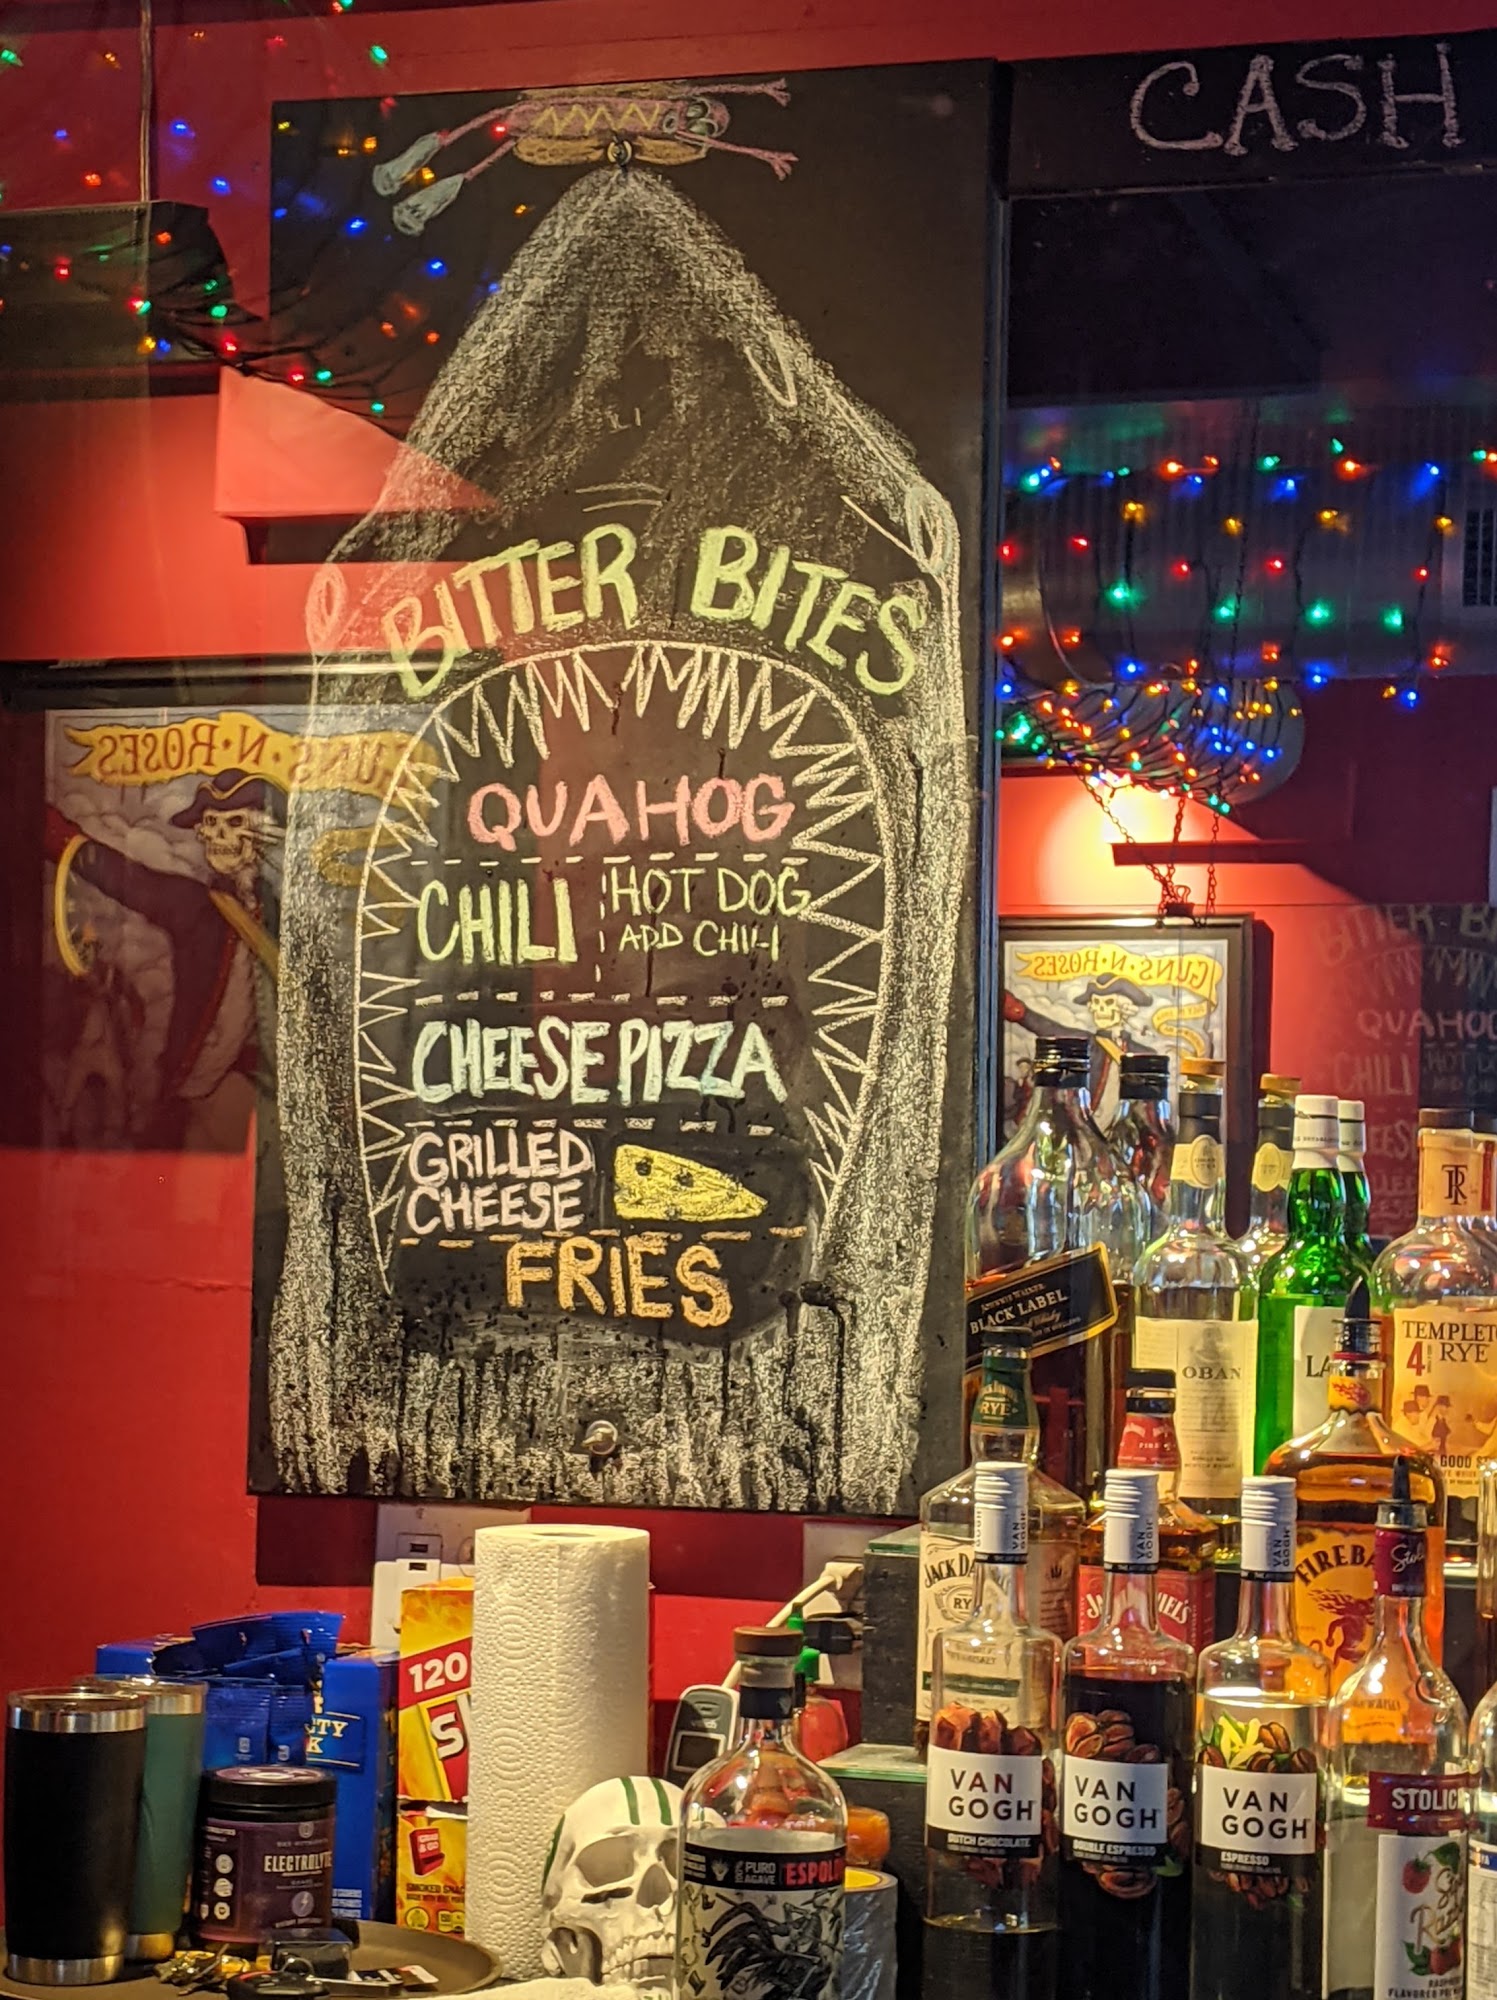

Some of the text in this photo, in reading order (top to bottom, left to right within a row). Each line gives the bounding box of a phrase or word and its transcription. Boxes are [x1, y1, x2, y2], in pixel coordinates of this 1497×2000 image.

[1130, 43, 1465, 156] CASH
[382, 523, 929, 698] BITTER BITES
[466, 774, 795, 852] QUAHOG
[610, 867, 811, 918] HOT DOG
[416, 878, 578, 965] CHILI
[619, 921, 780, 962] ADD CHILI
[411, 1015, 788, 1107] CHEESE PIZZA
[408, 1129, 594, 1187] GRILLED
[406, 1179, 585, 1235] CHEESE
[507, 1235, 733, 1327] FRIES
[970, 1306, 1016, 1334] BLACK
[1018, 1289, 1069, 1316] LABEL
[1406, 1341, 1426, 1376] 4
[1440, 1342, 1490, 1363] RYE
[1182, 1366, 1242, 1380] OBAN
[979, 1401, 1012, 1416] RYE
[1440, 1455, 1472, 1469] GOOD
[1136, 1531, 1145, 1559] VAN
[1273, 1539, 1282, 1567] VAN
[1283, 1529, 1291, 1567] GOGH
[925, 1557, 959, 1588] JACK
[1296, 1544, 1375, 1587] FIREBA
[953, 1597, 973, 1610] RY
[409, 1651, 468, 1694] 120
[950, 1768, 1013, 1794] VAN
[1075, 1775, 1136, 1802] VAN
[948, 1796, 1033, 1821] GOGH
[1222, 1787, 1288, 1813] VAN
[1074, 1803, 1157, 1829] GOGH
[1221, 1814, 1308, 1840] GOGH
[977, 1836, 1031, 1847] CHOCOLATE
[1072, 1839, 1105, 1854] DOUBLE
[1106, 1844, 1157, 1857] ESPRESSO
[745, 1861, 776, 1874] PURO
[1220, 1851, 1270, 1866] ESPRESSO
[744, 1875, 776, 1885] AGAVE
